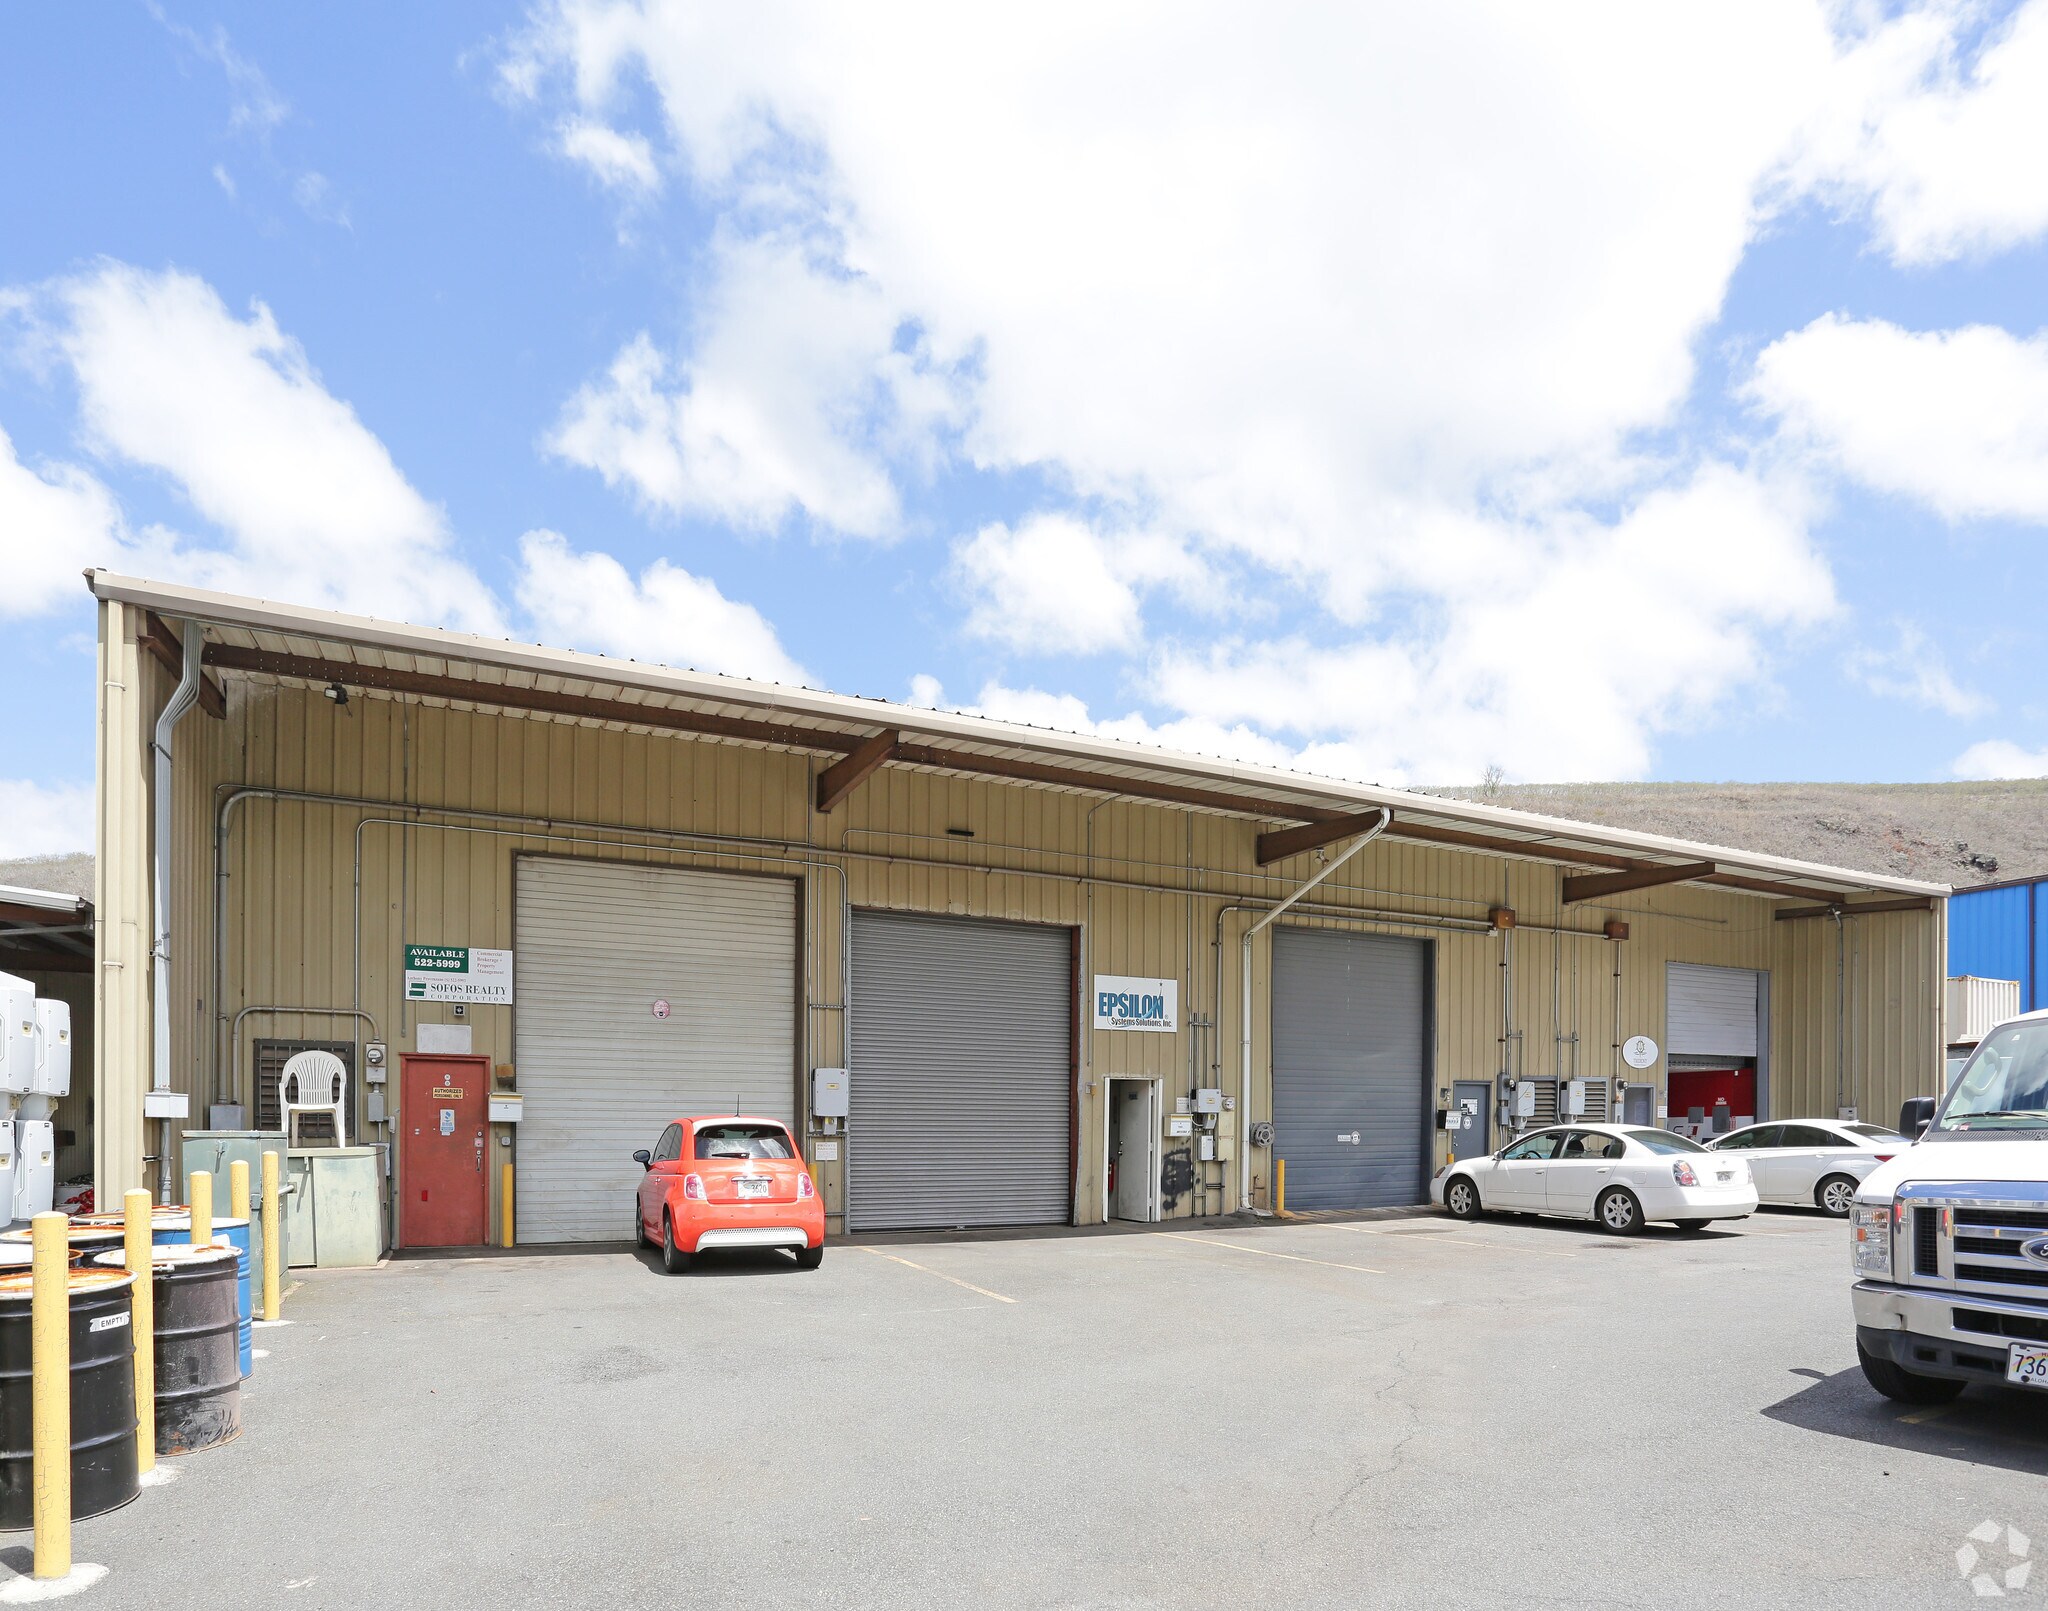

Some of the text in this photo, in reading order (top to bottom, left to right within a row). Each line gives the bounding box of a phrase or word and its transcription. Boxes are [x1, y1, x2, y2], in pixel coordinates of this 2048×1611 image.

[410, 948, 465, 958] AVAILABLE
[414, 958, 461, 968] 522-5999
[430, 983, 507, 995] SOFOS REALTY
[1099, 992, 1164, 1019] EPSILON
[1111, 1017, 1136, 1026] Systems
[100, 1316, 123, 1328] EMPTY
[2014, 1353, 2047, 1376] 736
